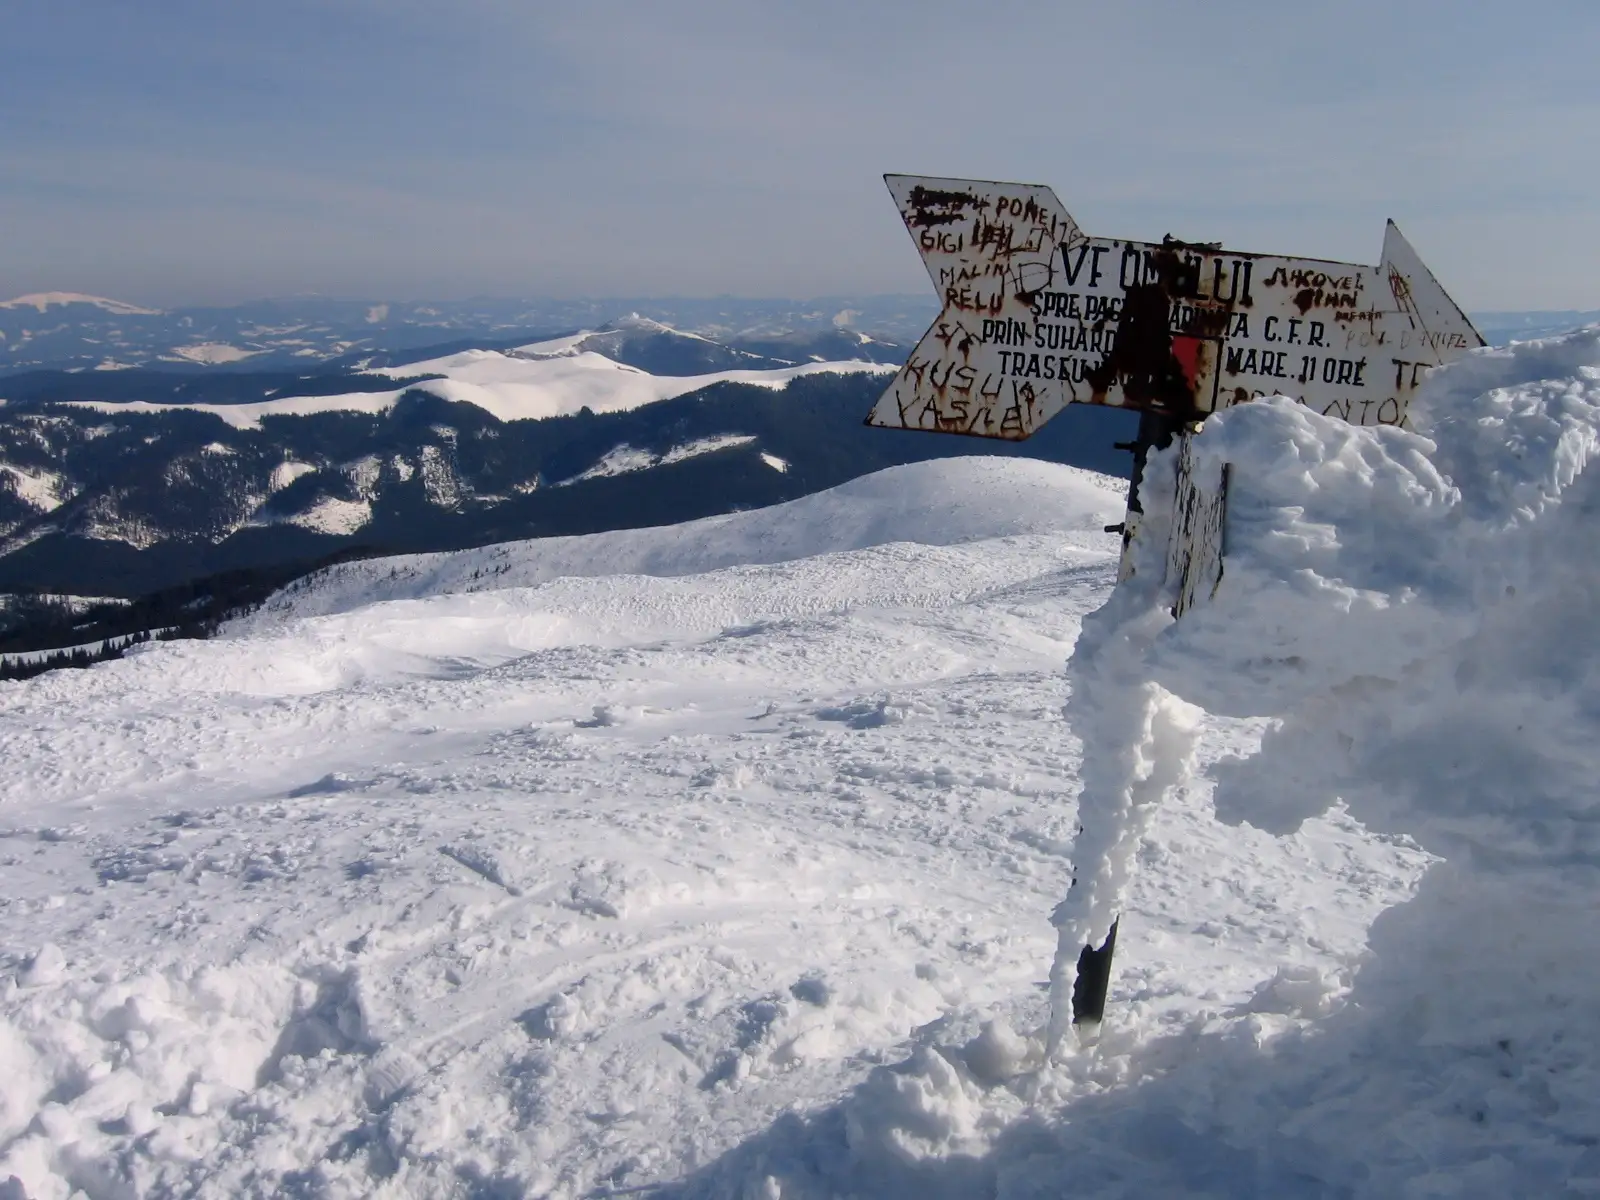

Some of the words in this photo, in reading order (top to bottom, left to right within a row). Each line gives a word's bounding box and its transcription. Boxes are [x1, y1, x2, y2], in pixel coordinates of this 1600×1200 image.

[982, 317, 1027, 347] PRIN
[1030, 291, 1080, 319] SPRE
[1264, 315, 1331, 347] C.F.R.
[998, 350, 1088, 384] TRASEU
